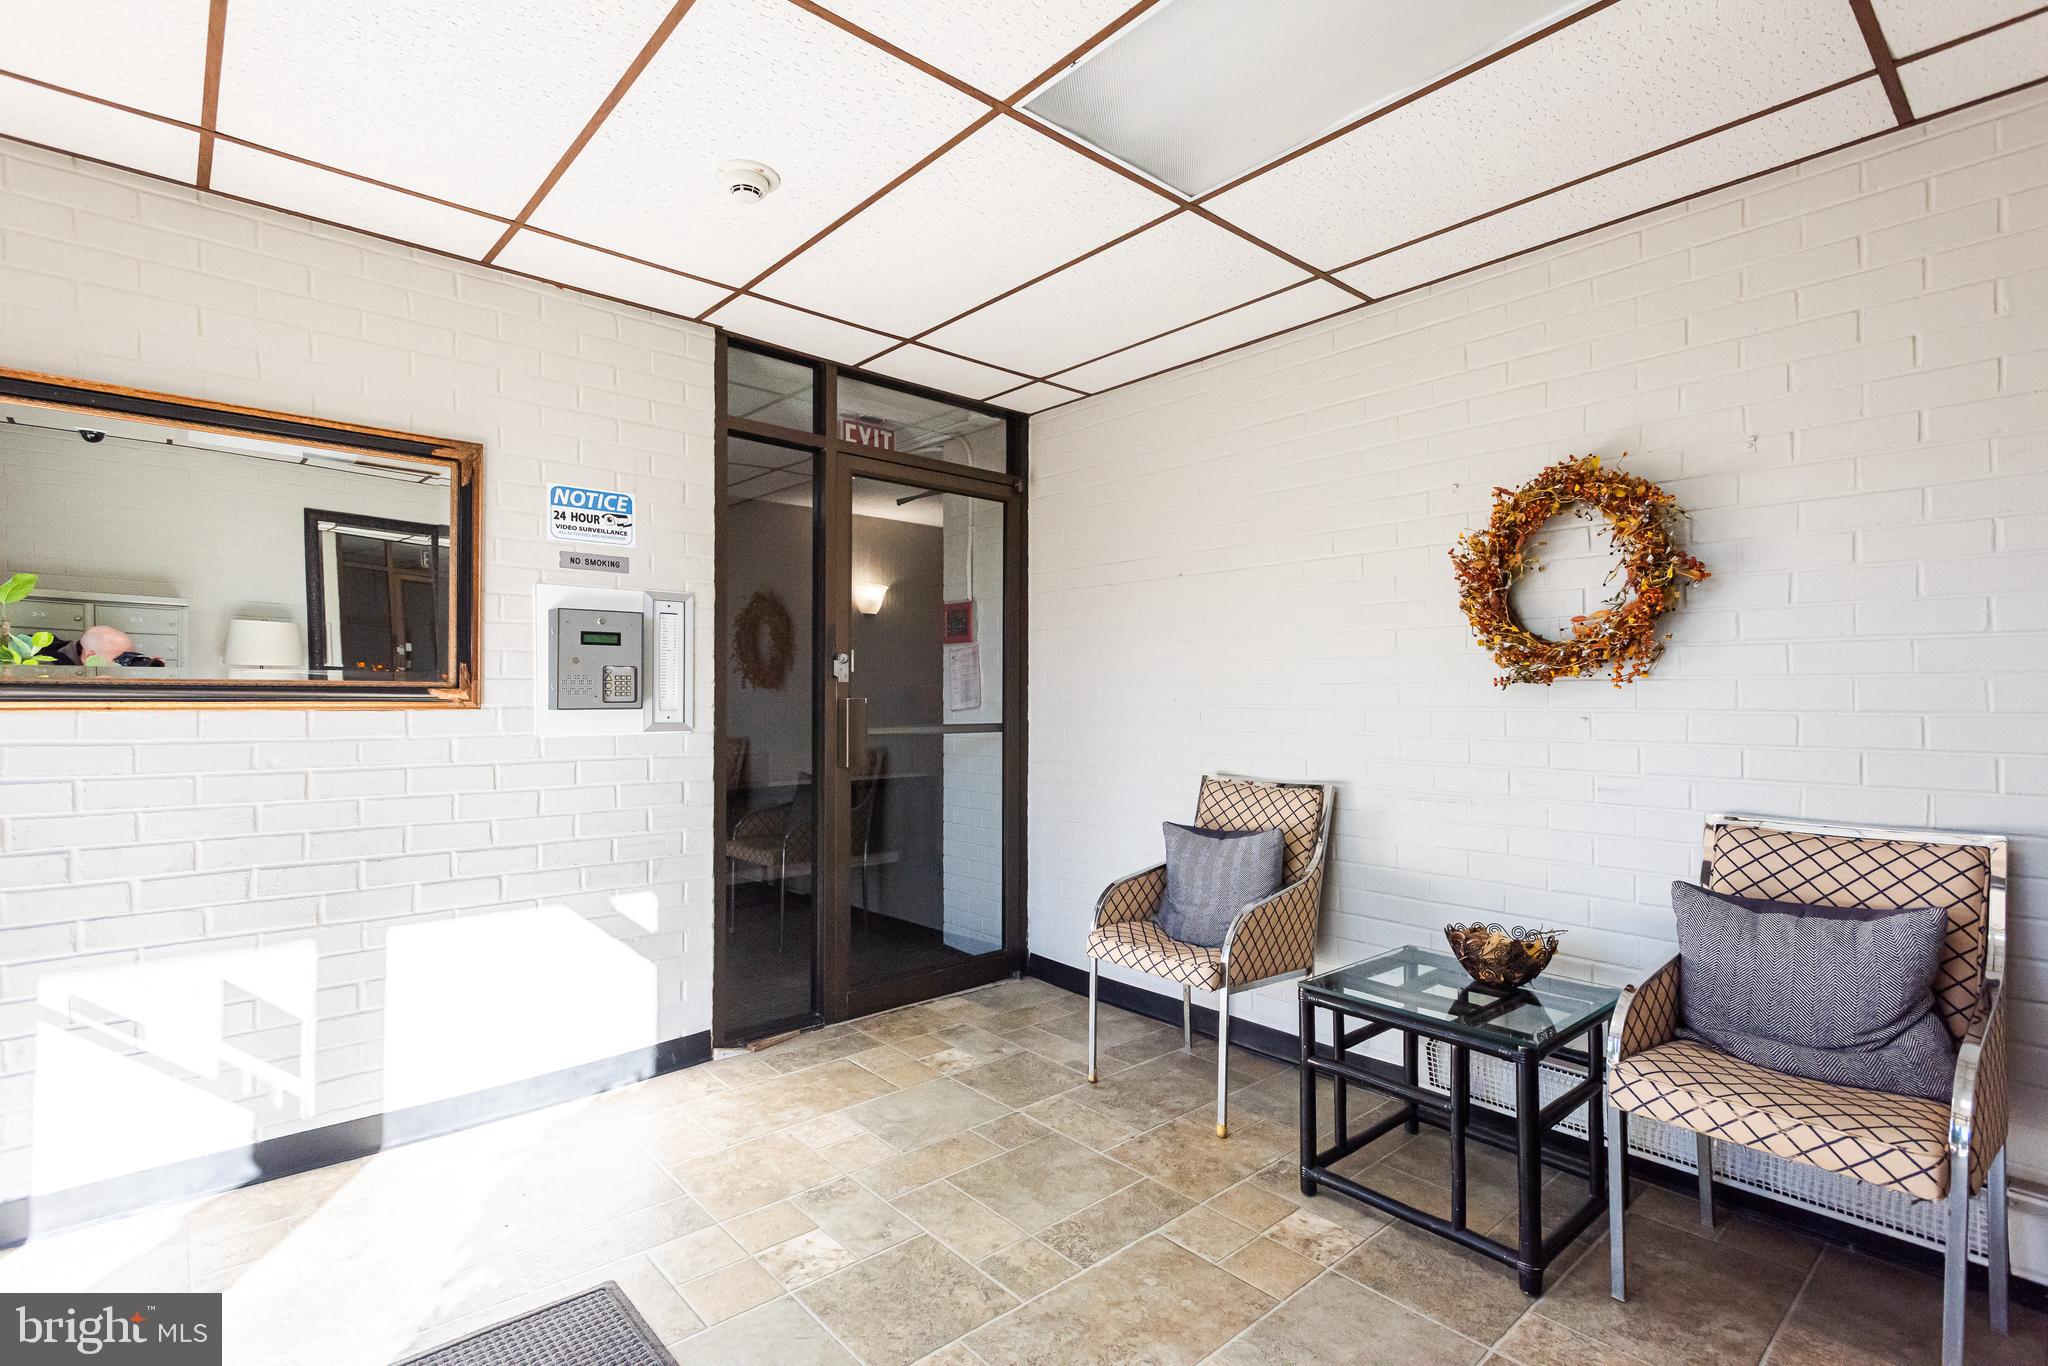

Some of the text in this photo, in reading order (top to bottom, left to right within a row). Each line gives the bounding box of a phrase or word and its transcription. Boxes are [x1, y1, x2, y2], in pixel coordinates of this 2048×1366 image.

[553, 487, 629, 513] NOTICE
[553, 510, 600, 525] 24 HOUR
[555, 523, 628, 537] VIDEO SURVEILLANCE
[569, 556, 621, 569] NO SMOKING
